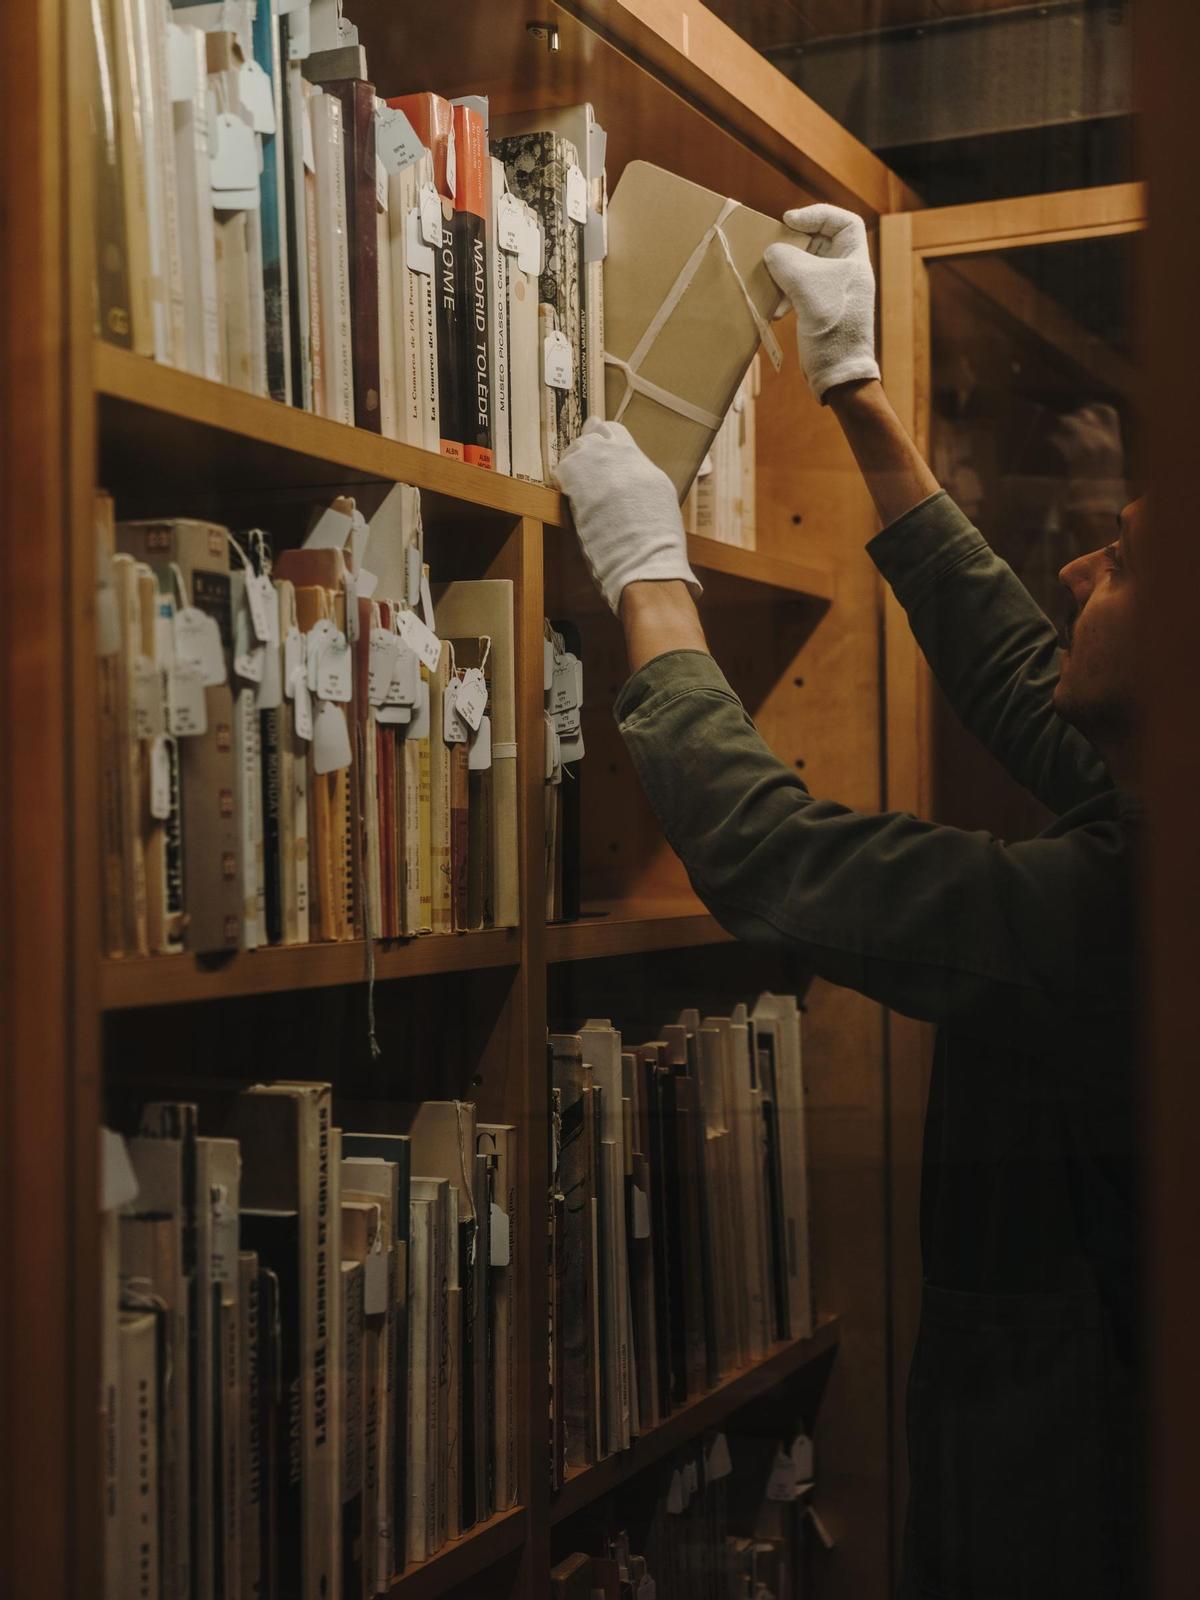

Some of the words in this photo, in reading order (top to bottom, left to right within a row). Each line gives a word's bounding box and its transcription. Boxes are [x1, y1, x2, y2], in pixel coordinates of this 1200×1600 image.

[442, 229, 456, 311] ROME
[473, 238, 486, 332] MADRID
[412, 406, 418, 419] La
[431, 407, 436, 421] La
[476, 341, 490, 427] TOLÈDE
[445, 447, 459, 456] ALBIN
[318, 1106, 328, 1217] GOUACHES
[318, 1219, 327, 1247] ET
[316, 1251, 327, 1339] DESSINS
[438, 1279, 447, 1387] Picasso
[314, 1344, 327, 1449] LEGER
